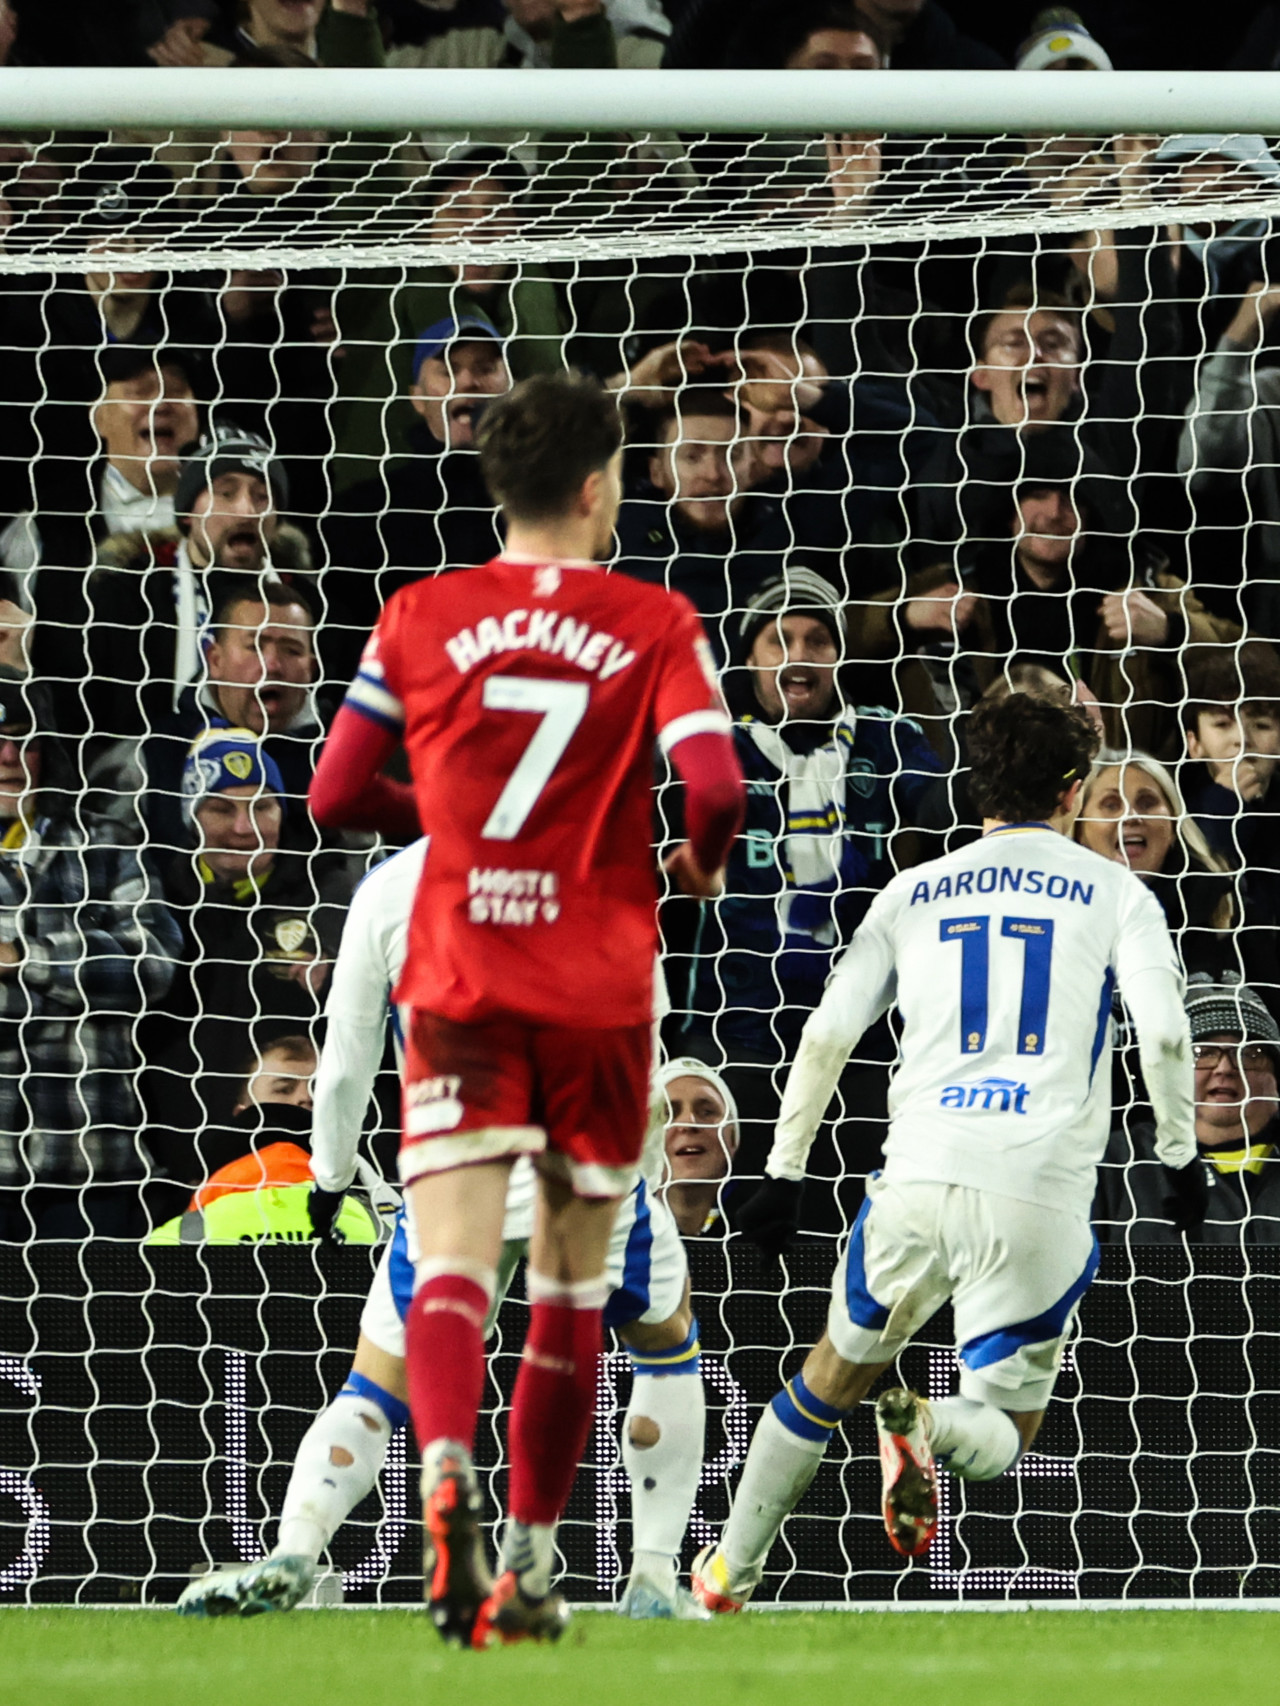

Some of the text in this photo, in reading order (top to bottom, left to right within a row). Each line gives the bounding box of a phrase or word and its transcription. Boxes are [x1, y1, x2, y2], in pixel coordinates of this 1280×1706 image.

[445, 608, 637, 681] HACKNEY
[481, 675, 590, 841] 7
[469, 896, 538, 926] STAY
[910, 866, 1094, 906] AARONSON
[939, 914, 1054, 1056] 11
[939, 1076, 1030, 1115] amt
